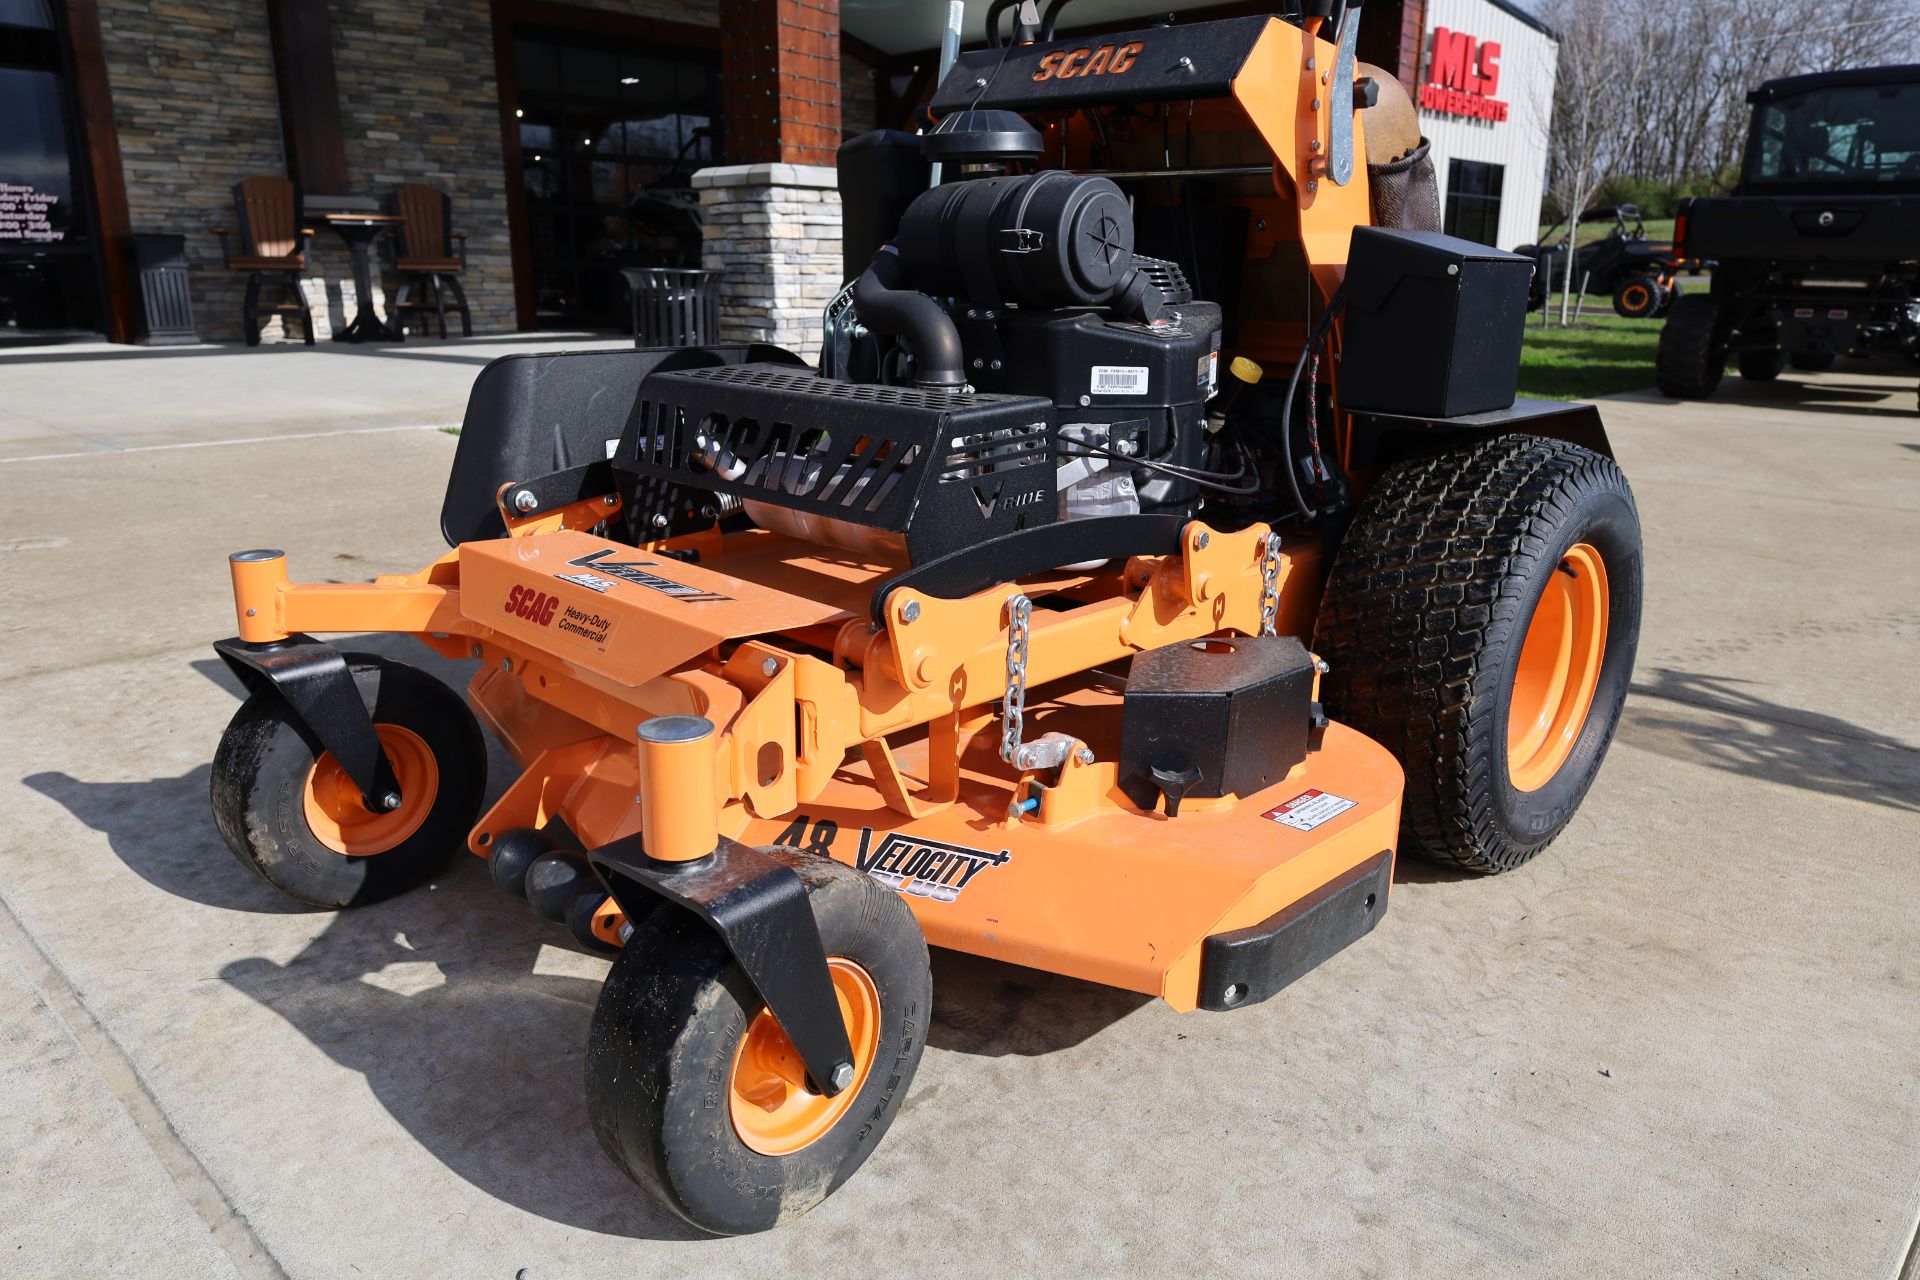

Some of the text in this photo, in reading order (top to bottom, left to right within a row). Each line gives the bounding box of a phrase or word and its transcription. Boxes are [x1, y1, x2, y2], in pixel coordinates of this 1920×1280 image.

[1031, 41, 1145, 81] SCAG
[1429, 27, 1501, 96] MLS
[686, 411, 832, 497] SCAG
[504, 584, 560, 627] SCAG
[564, 606, 611, 632] Heavy-Duty
[558, 618, 607, 643] Commercial
[773, 815, 839, 858] 48
